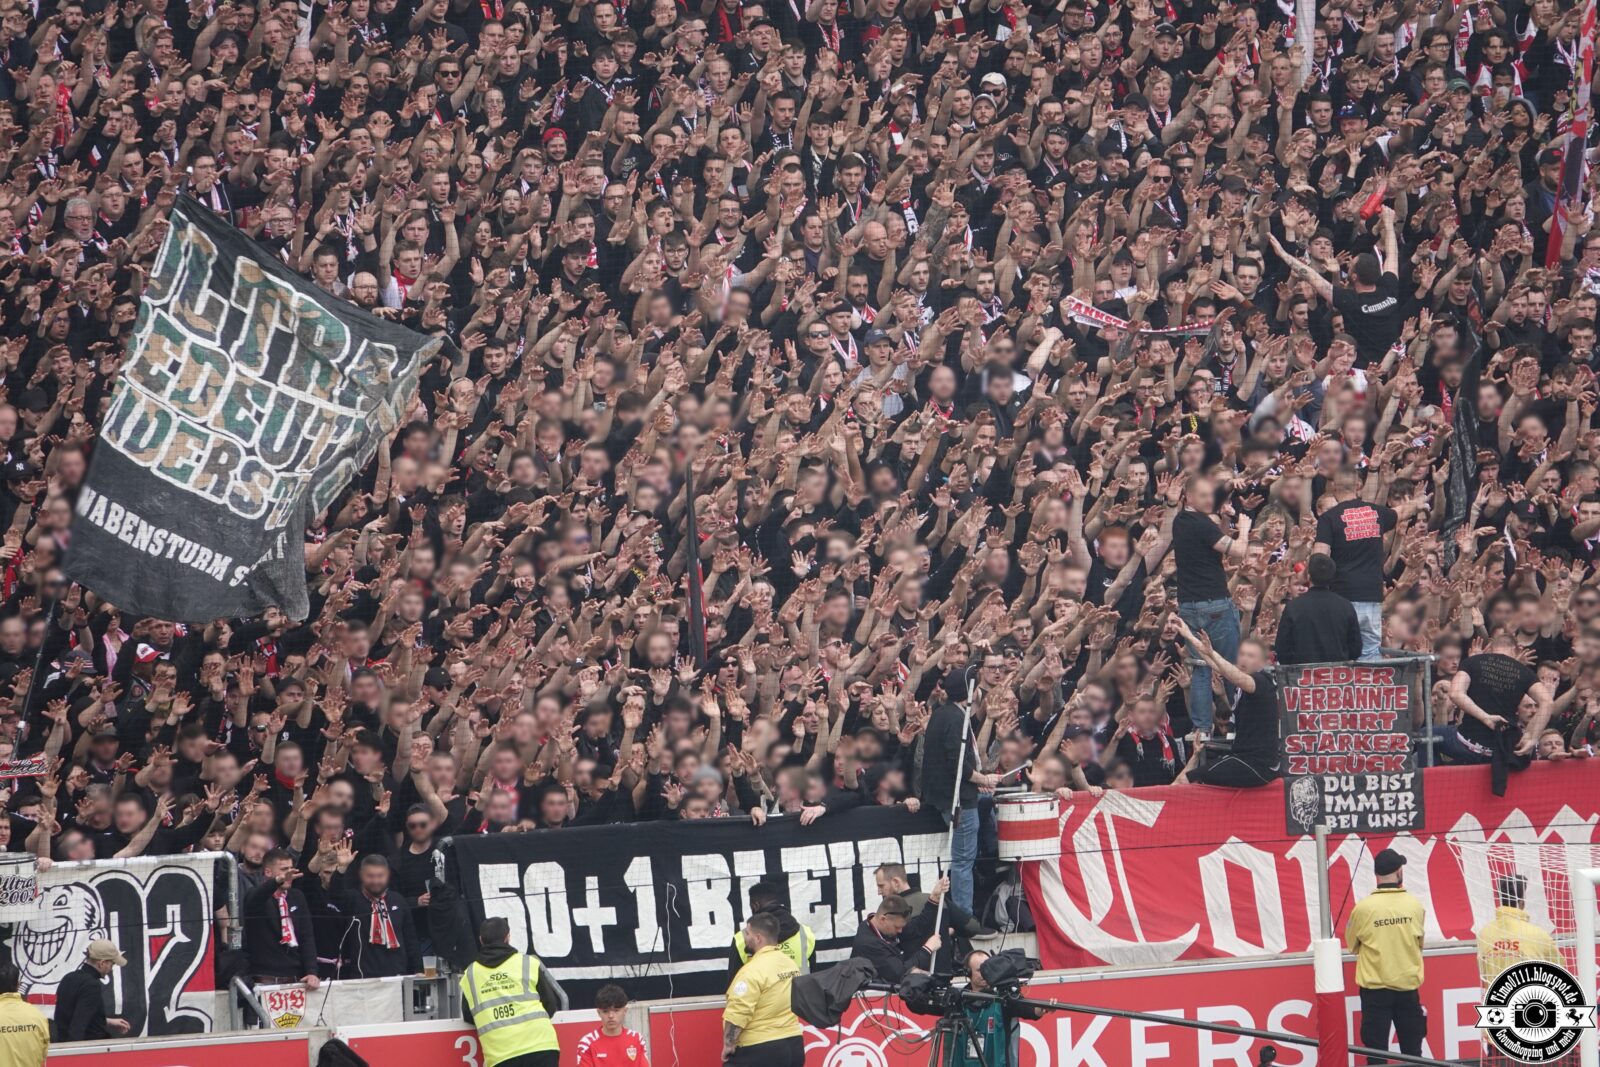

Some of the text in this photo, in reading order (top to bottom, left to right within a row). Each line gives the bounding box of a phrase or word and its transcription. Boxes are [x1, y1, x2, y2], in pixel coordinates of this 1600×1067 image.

[1298, 666, 1396, 686] JEDER
[1283, 685, 1409, 712] VERBANNTE
[1297, 711, 1397, 732] KEHRT
[1288, 751, 1407, 774] ZURÜCK
[1323, 772, 1416, 792] DU BIST
[1324, 791, 1416, 812] IMMER
[1325, 811, 1418, 829] BEI UNS!
[479, 856, 665, 957] 50+1
[1373, 916, 1413, 928] SECURITY
[489, 972, 509, 981] SDS
[269, 990, 305, 1011] VfB
[493, 1004, 515, 1020] 0695
[0, 1024, 37, 1034] ECURITY
